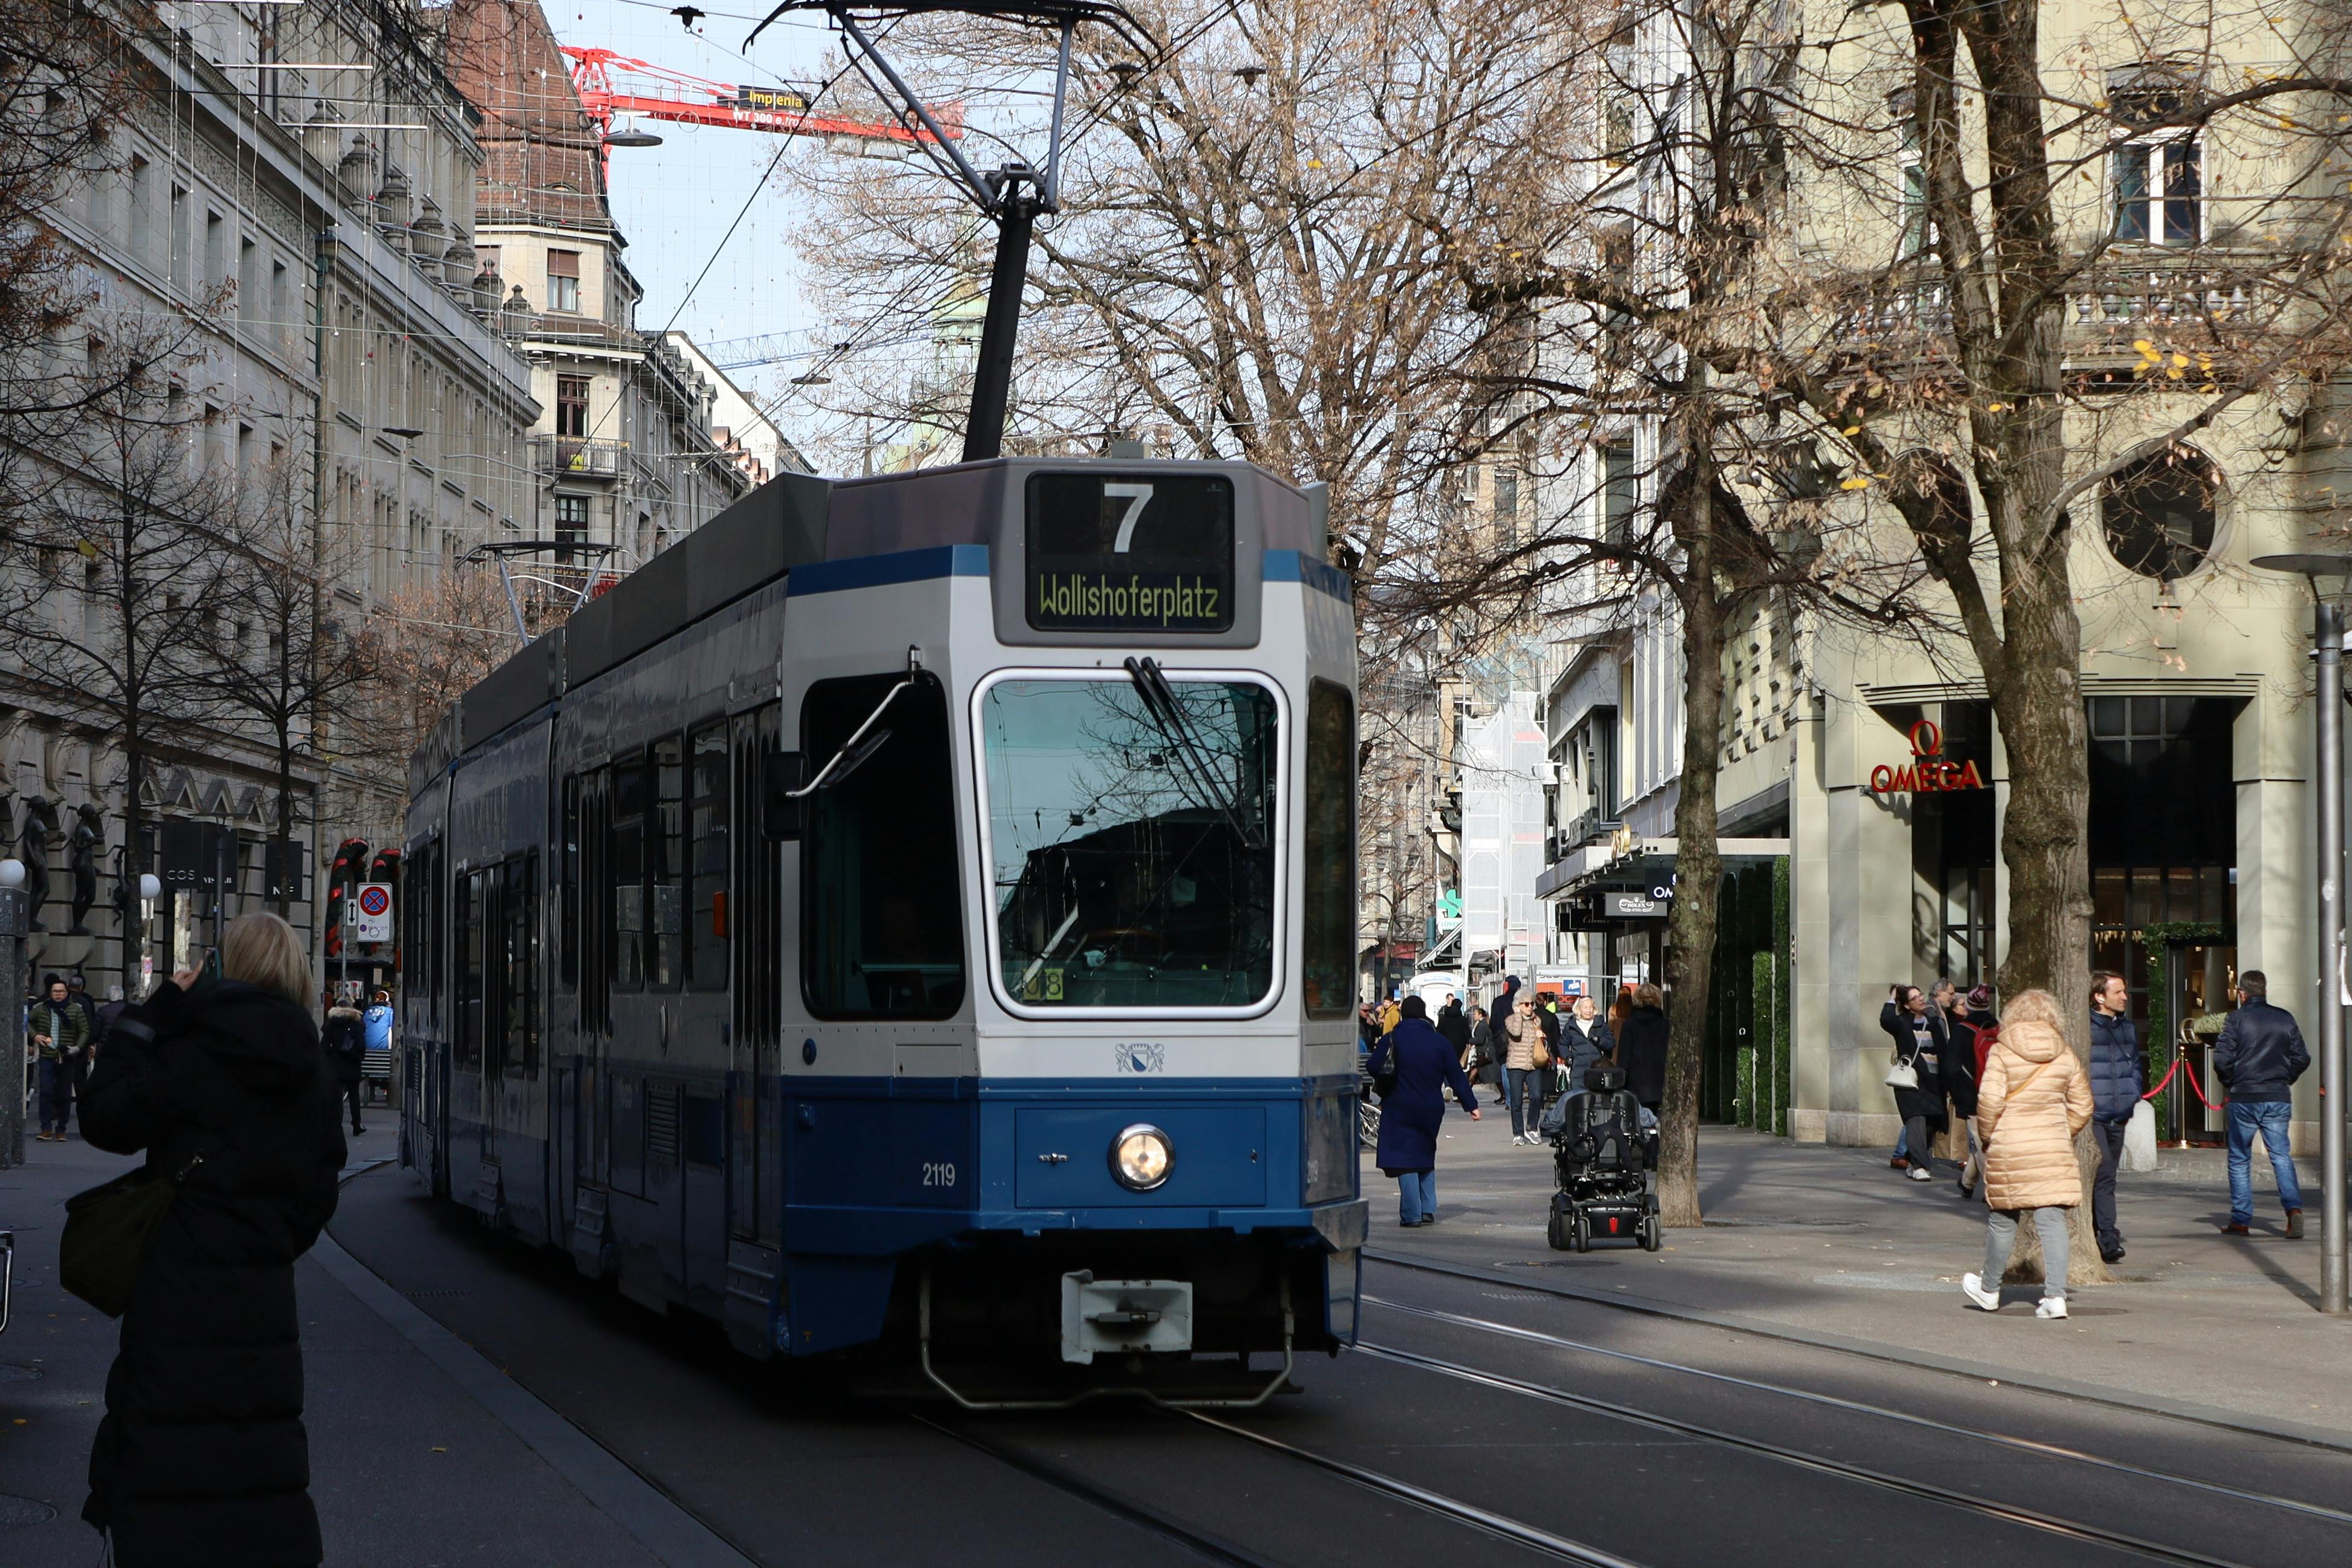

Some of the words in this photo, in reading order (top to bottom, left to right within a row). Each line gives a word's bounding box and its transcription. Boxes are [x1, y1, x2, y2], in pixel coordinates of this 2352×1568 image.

[750, 90, 802, 108] Impenia
[754, 112, 773, 123] 300
[1104, 483, 1154, 553] 7
[1040, 574, 1218, 627] Wollishoferplatz
[1871, 760, 1984, 793] OMEGA
[167, 870, 195, 880] COS
[923, 1163, 955, 1187] 2119
